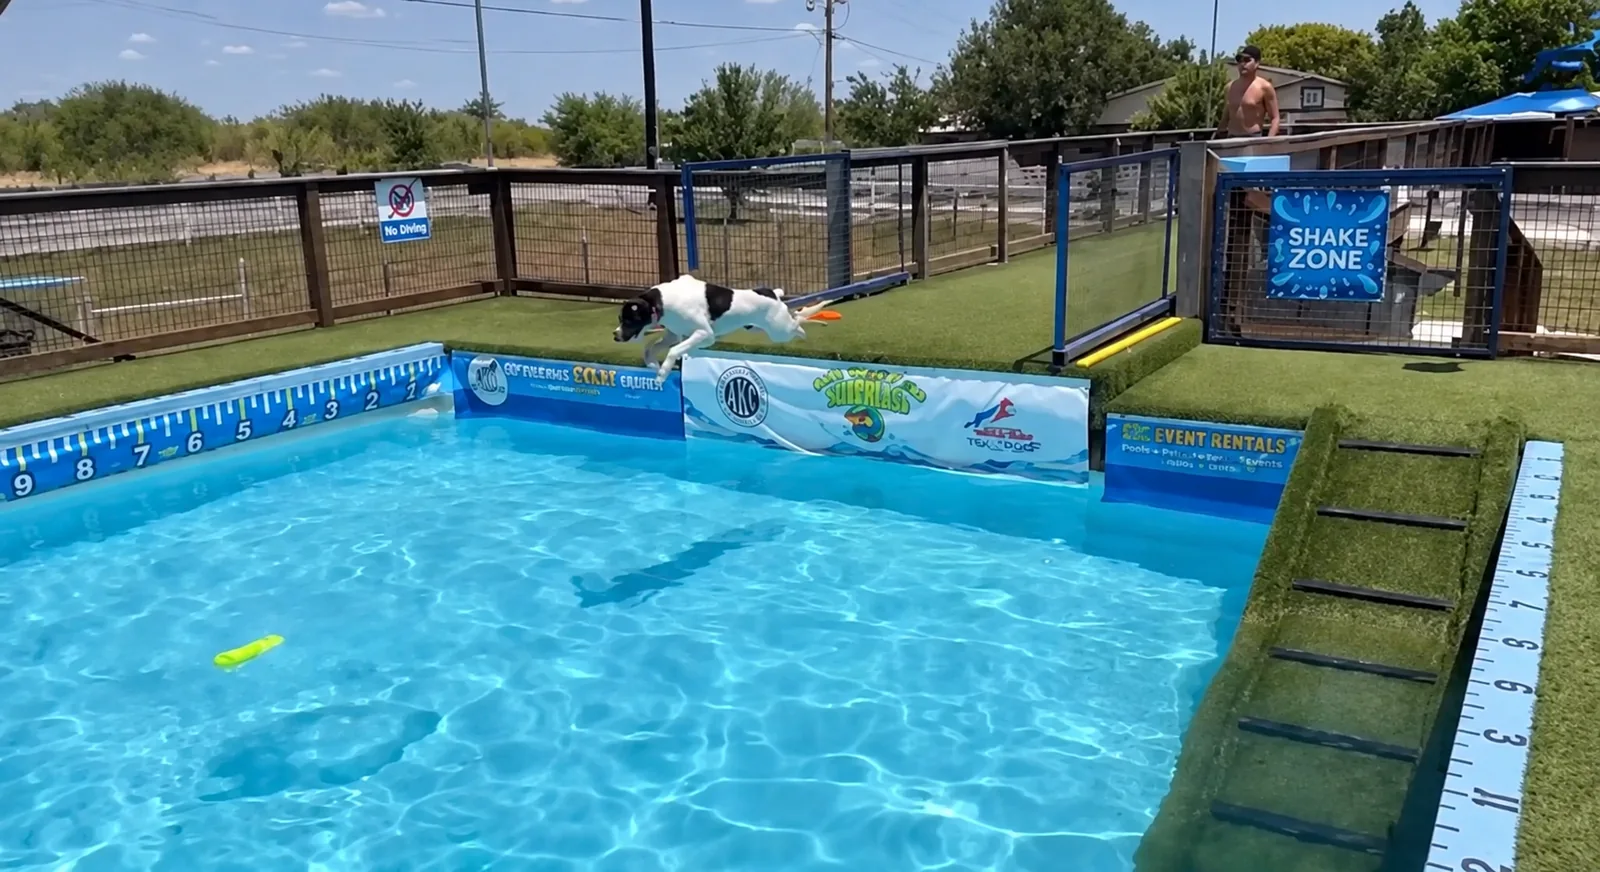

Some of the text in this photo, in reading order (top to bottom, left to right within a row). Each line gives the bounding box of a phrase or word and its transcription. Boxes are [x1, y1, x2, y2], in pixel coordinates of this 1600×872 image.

[384, 222, 427, 236] No Diving
[1289, 228, 1369, 247] SHAKE
[1288, 249, 1363, 270] ZONE
[727, 379, 757, 416] AKC
[14, 474, 33, 496] 9
[76, 459, 94, 480] 8
[133, 445, 150, 466] 7
[187, 433, 202, 452] 6
[236, 421, 251, 440] 5
[282, 410, 297, 427] 4
[325, 401, 338, 419] 3
[365, 392, 379, 410] 2
[1122, 444, 1151, 454] Pools
[1155, 428, 1207, 447] EVENT
[1211, 432, 1286, 454] RENTALS
[1509, 600, 1544, 611] 7
